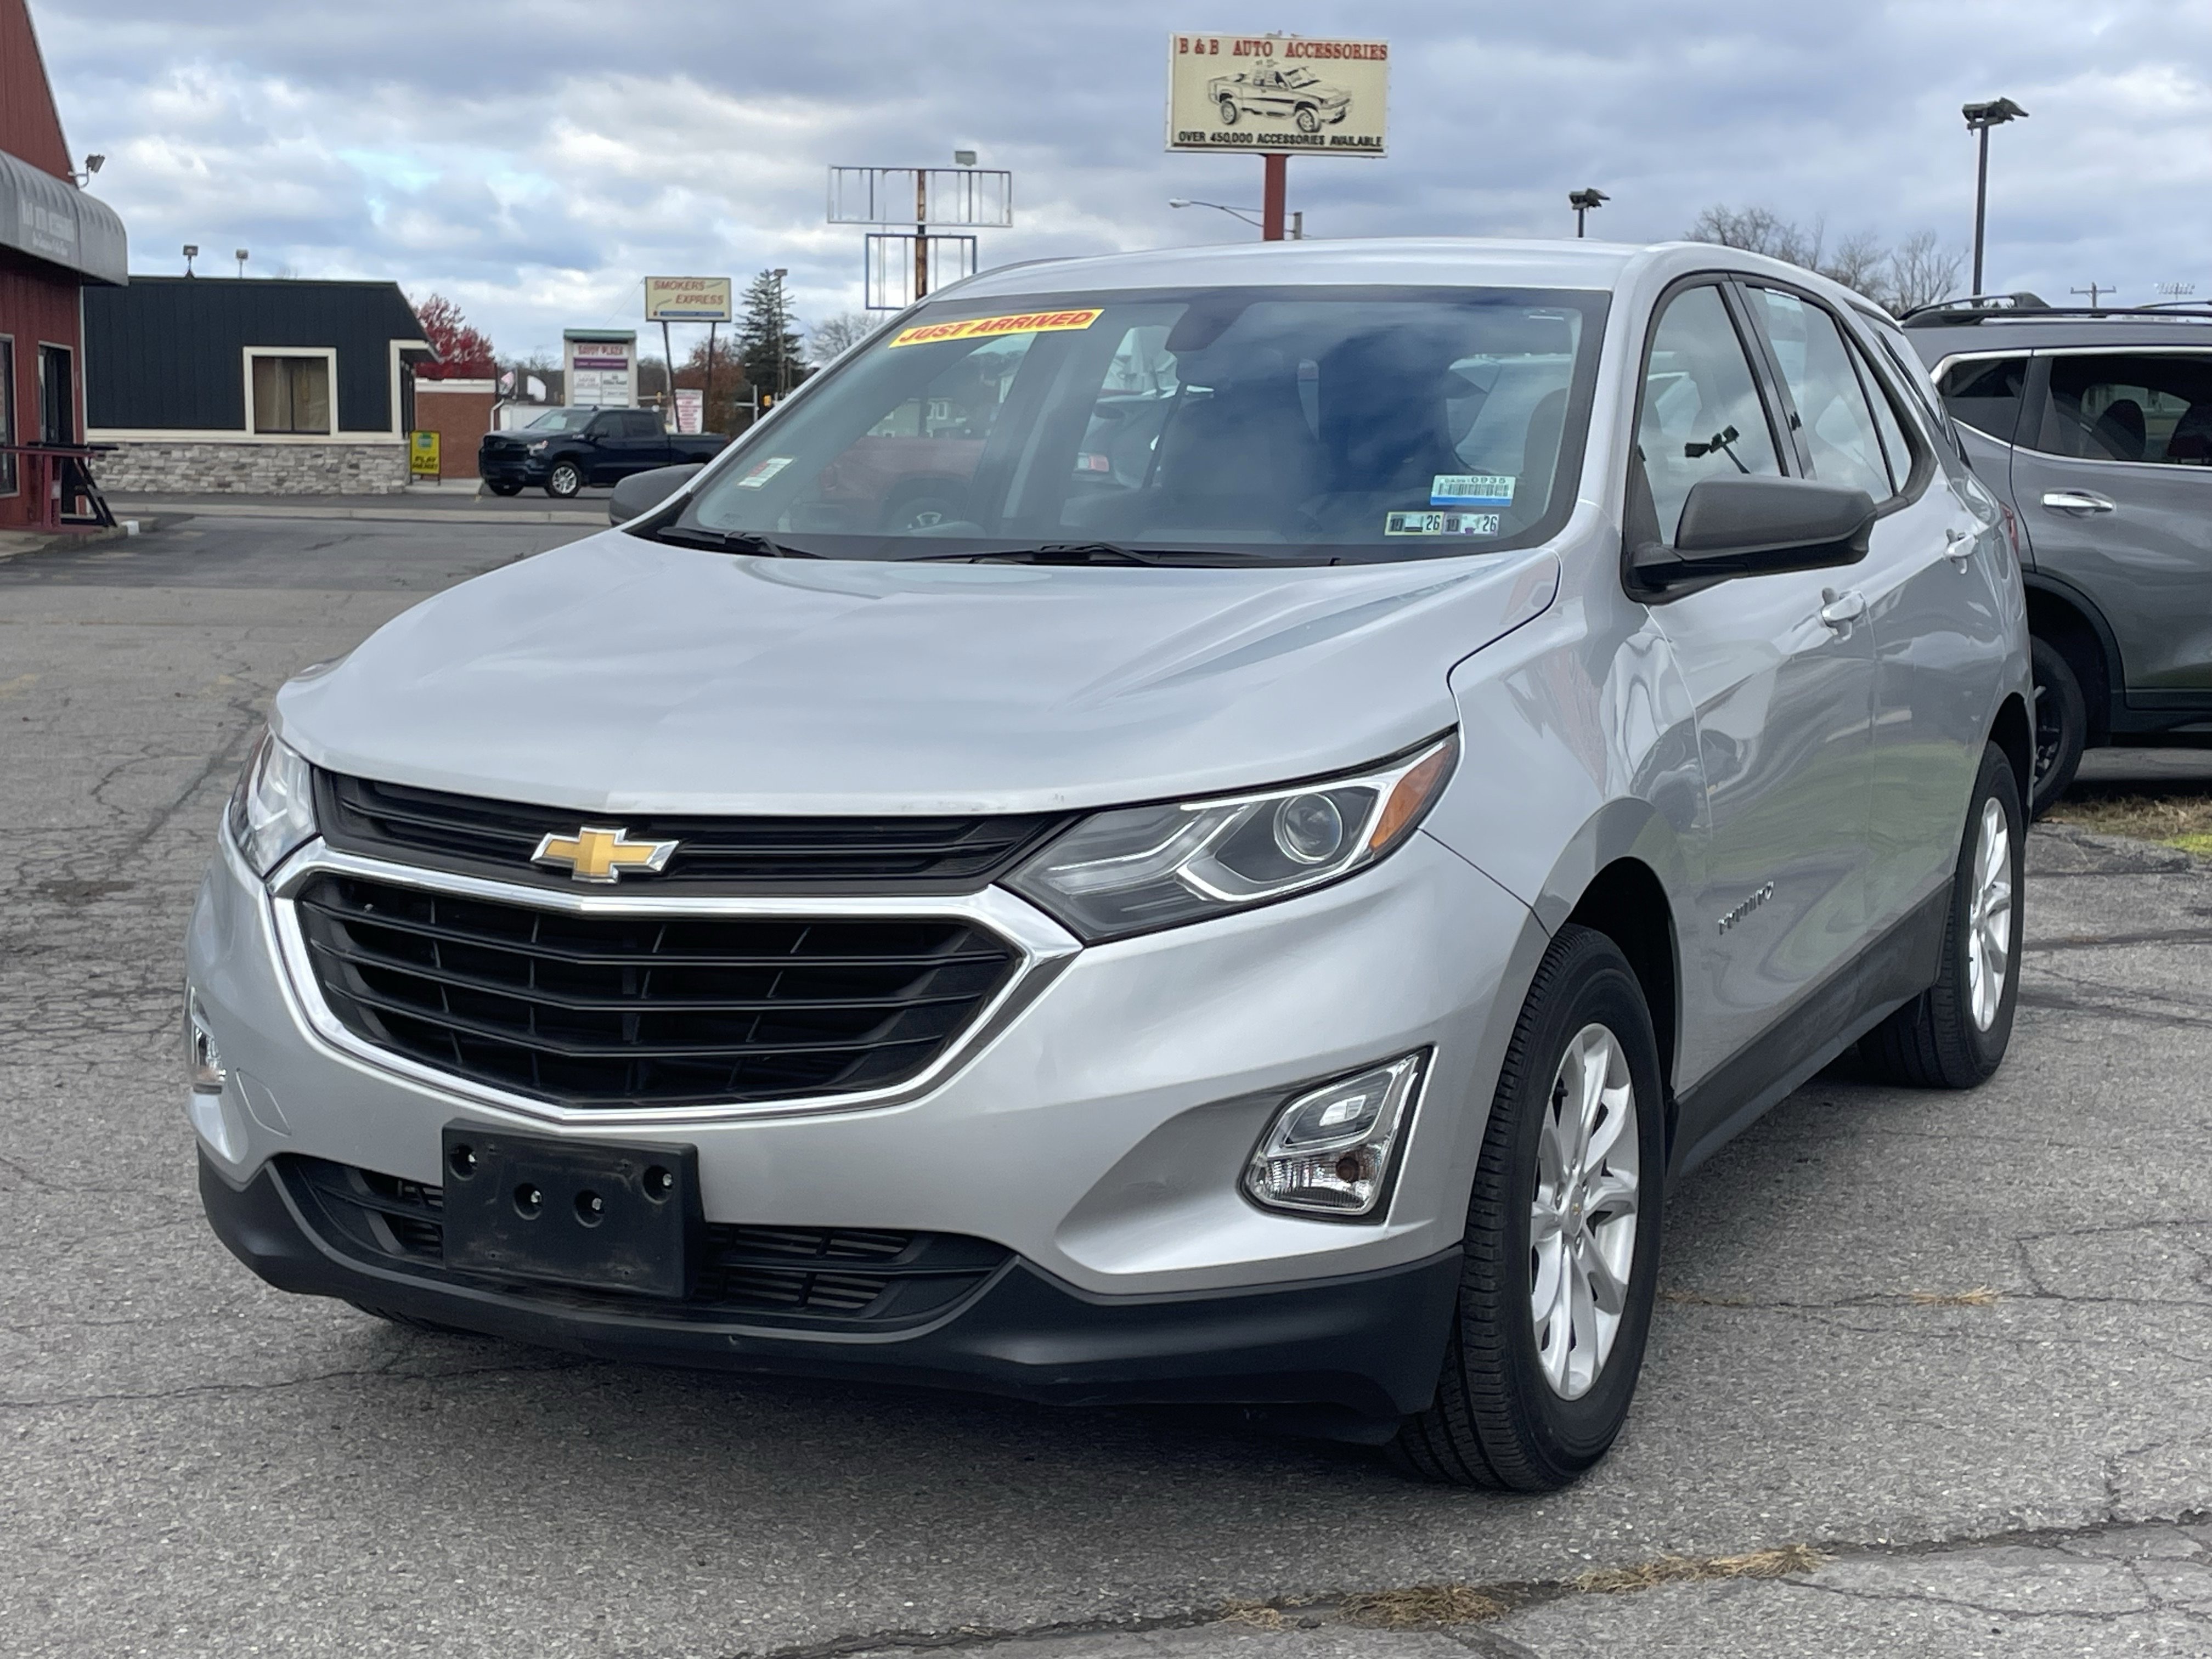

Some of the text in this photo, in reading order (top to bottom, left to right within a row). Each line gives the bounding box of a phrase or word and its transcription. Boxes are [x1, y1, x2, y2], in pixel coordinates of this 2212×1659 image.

[1180, 38, 1387, 60] B & B AUTO ACCESSORIES
[1179, 132, 1382, 146] OVER 450,000 ACCESSORIES AVAILABLE
[653, 280, 706, 291] SMOKERS
[675, 294, 725, 305] EXPRESS
[899, 311, 1094, 343] JUST ARRIVED
[1426, 515, 1441, 531] 26
[1483, 516, 1498, 532] 26
